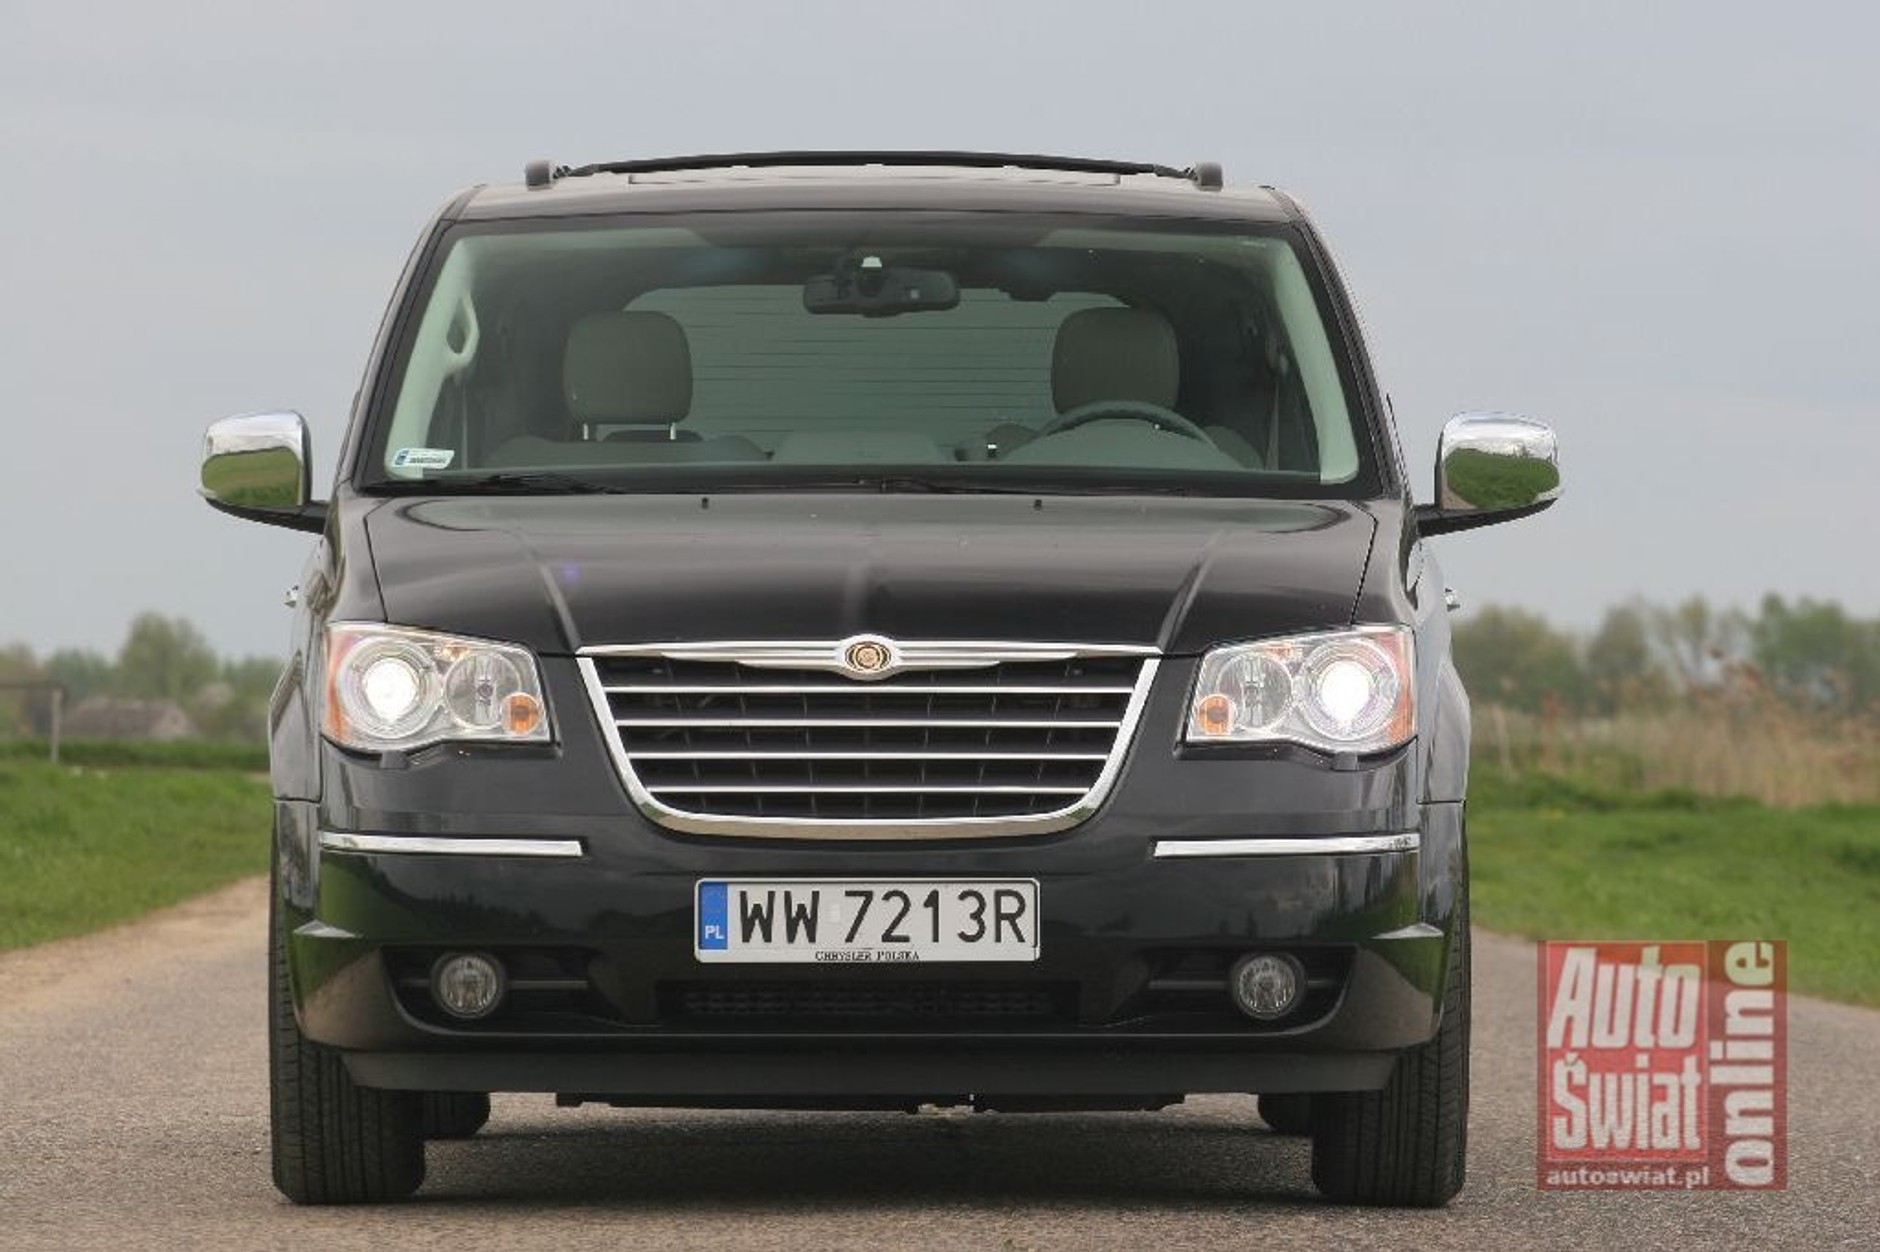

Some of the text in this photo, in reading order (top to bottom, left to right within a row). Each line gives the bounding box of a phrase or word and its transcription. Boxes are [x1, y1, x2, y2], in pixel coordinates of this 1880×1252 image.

[704, 924, 726, 940] PL
[739, 889, 1027, 944] WW 7213R
